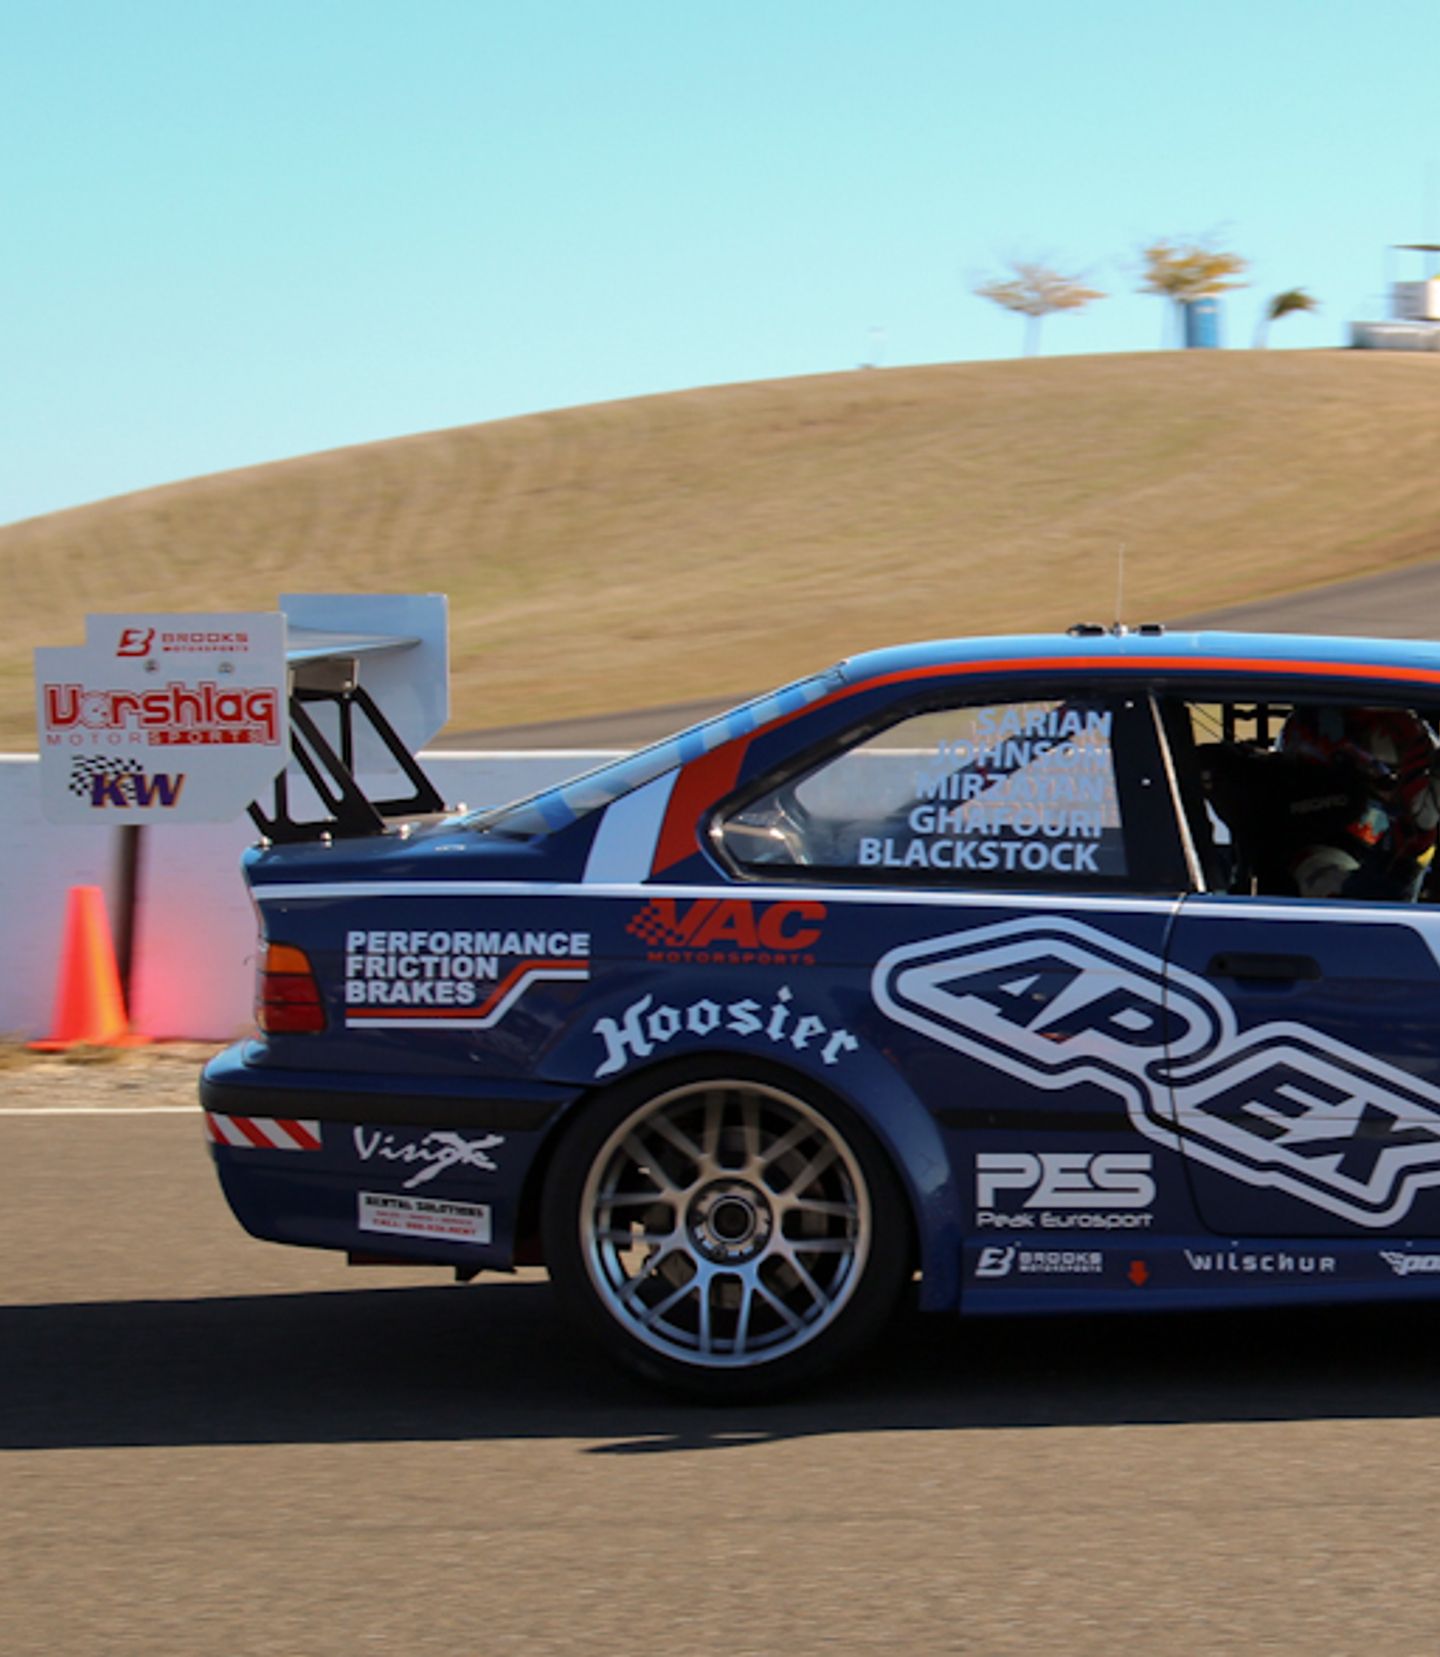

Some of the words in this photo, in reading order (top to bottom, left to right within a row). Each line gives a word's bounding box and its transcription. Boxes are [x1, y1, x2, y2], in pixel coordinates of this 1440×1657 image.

[162, 633, 248, 643] BROOKS
[976, 709, 1112, 738] SARIAN
[91, 772, 185, 808] KW
[859, 838, 1099, 872] BLACKSTOCK
[648, 898, 827, 950] VAC
[346, 931, 590, 956] PERFORMANCE
[346, 956, 498, 980] FRICTION
[647, 951, 816, 965] MOTORSPORTS
[346, 980, 477, 1004] BRAKES
[594, 985, 859, 1077] Hoosier
[976, 1153, 1156, 1208] PES
[976, 1212, 1035, 1228] Peak
[1040, 1212, 1153, 1230] Eurosport
[1019, 1252, 1102, 1265] BROOKS
